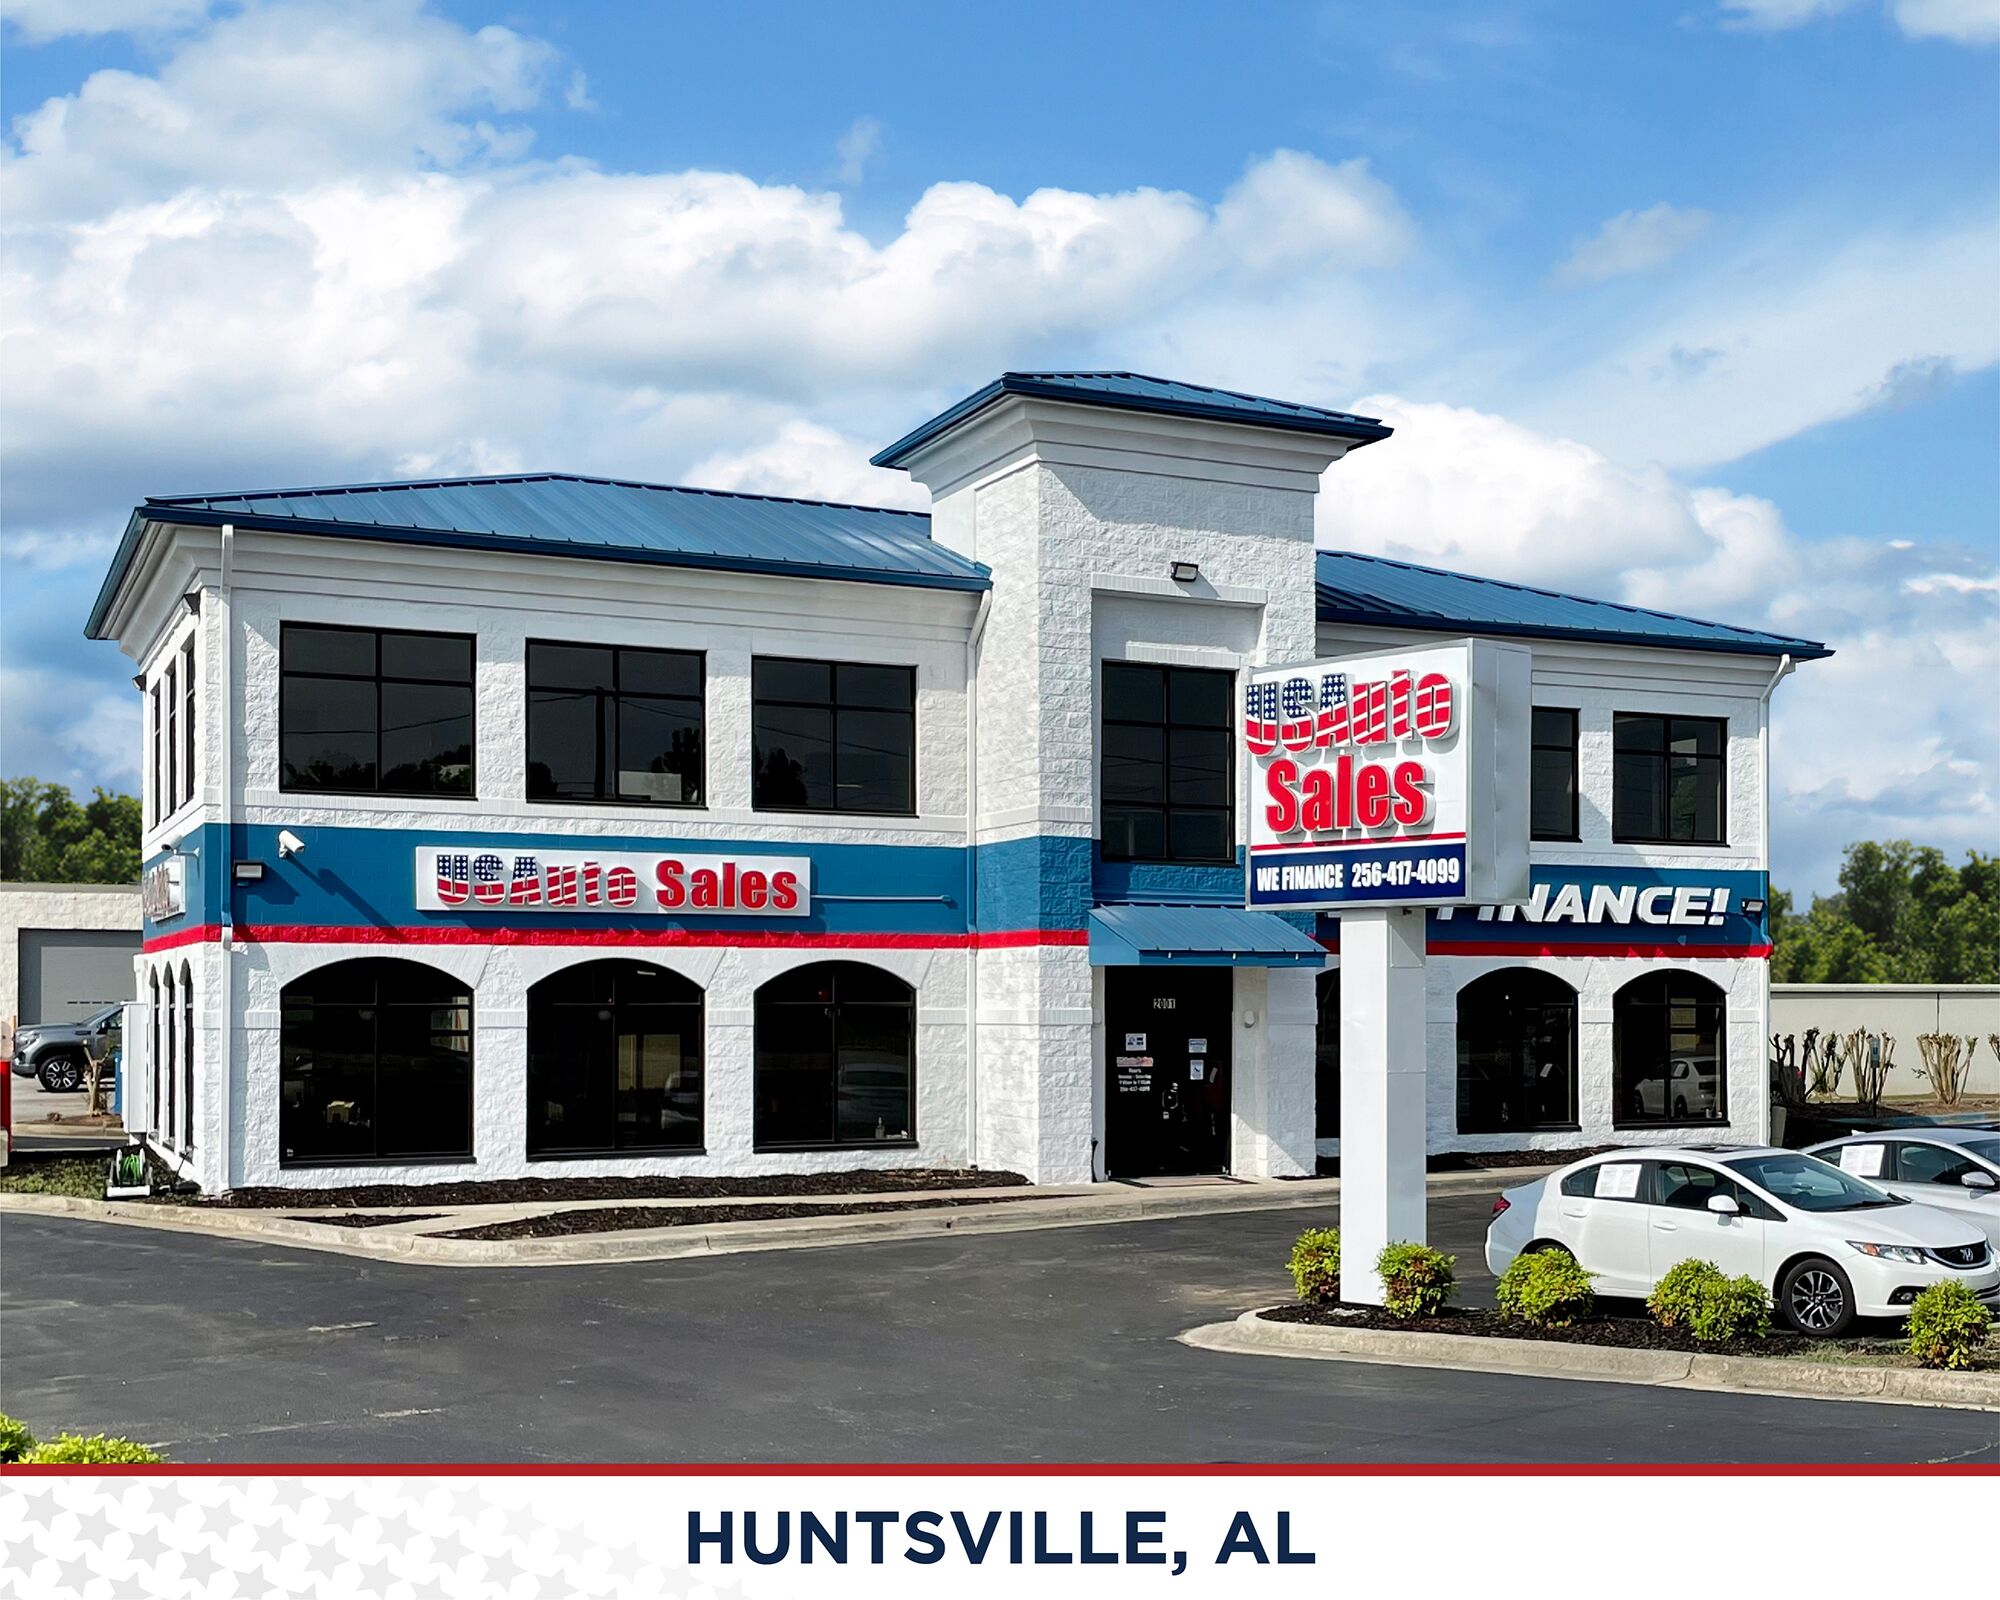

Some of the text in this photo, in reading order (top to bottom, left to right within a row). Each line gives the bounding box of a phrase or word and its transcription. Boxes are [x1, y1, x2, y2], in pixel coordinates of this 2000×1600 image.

[1246, 669, 1453, 756] USAuto
[1265, 753, 1428, 834] Sales
[436, 854, 799, 909] USAuto Sales
[1256, 857, 1460, 891] WE FINANCE 256-417-4099
